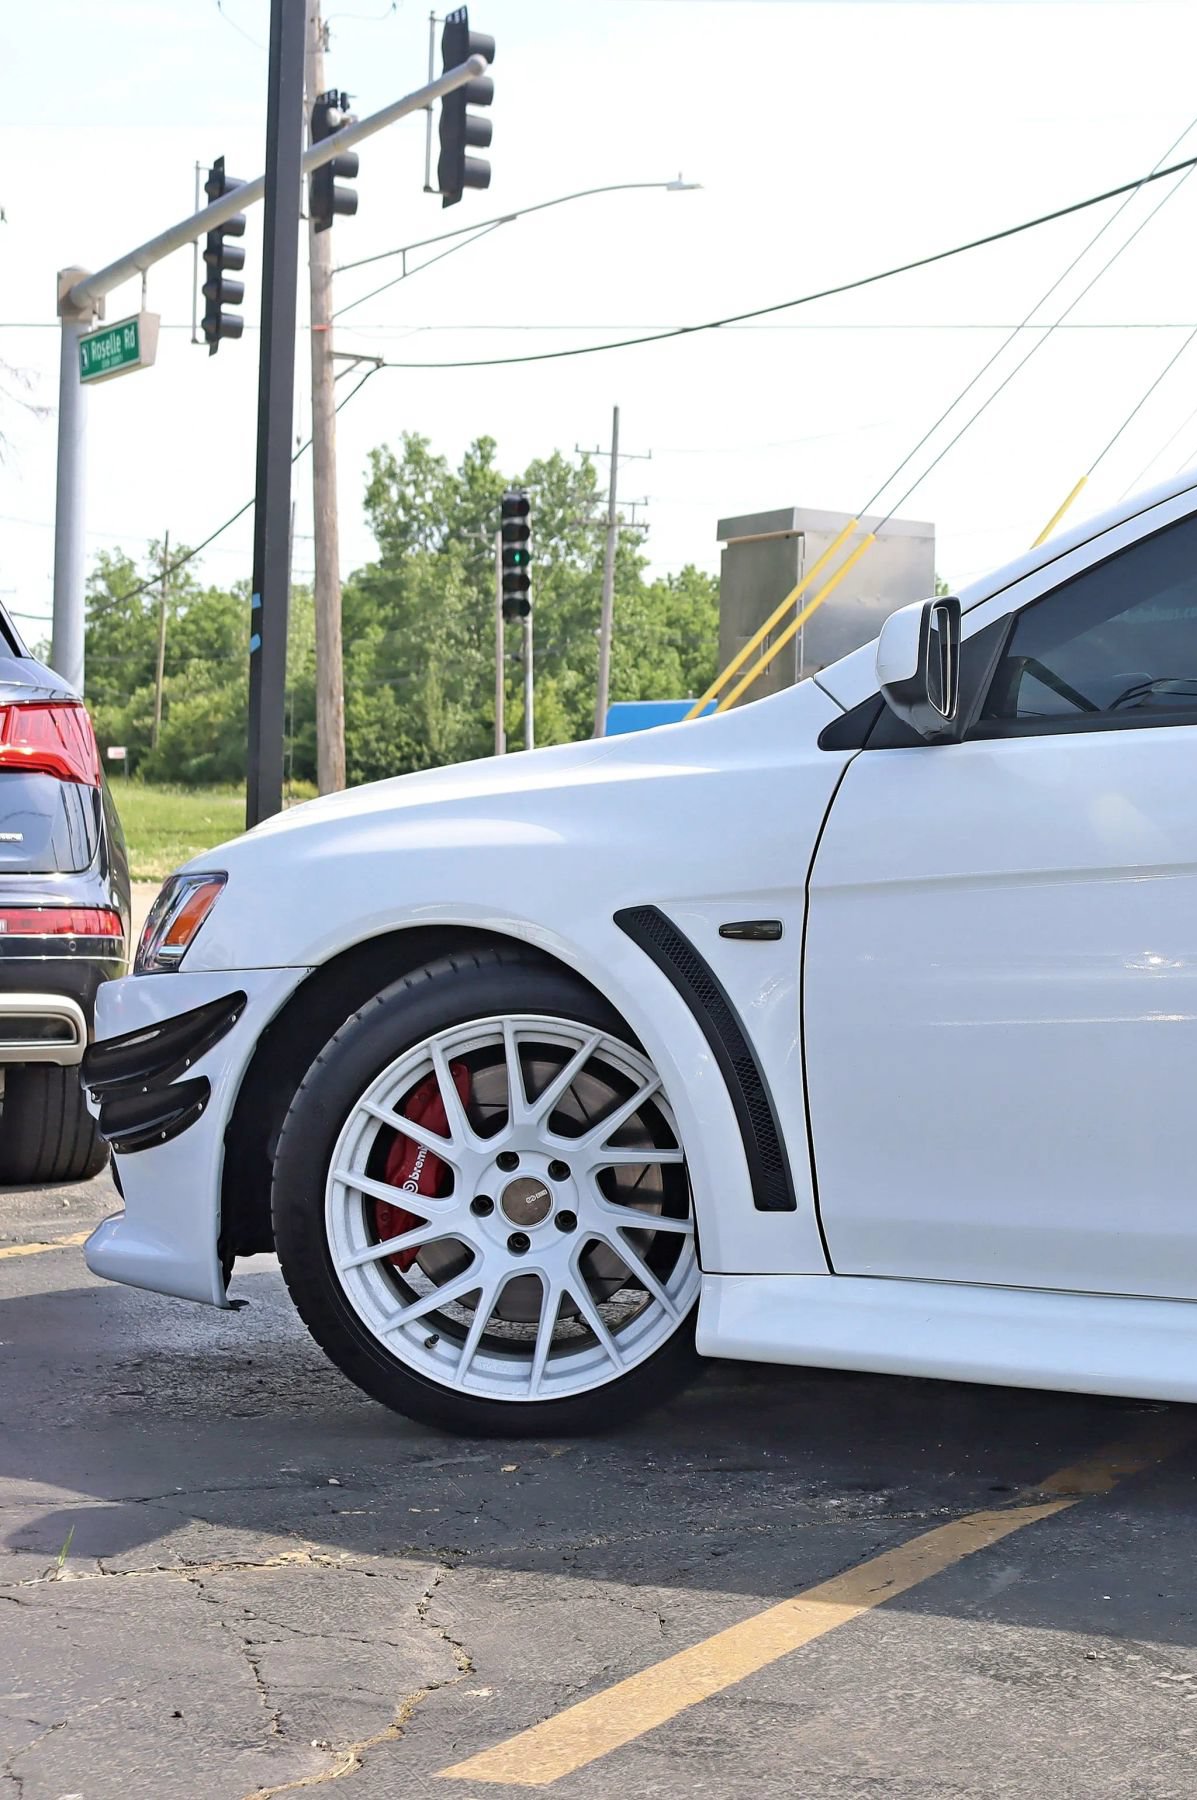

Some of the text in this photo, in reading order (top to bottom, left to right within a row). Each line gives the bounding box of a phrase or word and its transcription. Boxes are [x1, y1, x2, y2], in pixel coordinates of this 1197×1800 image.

[91, 332, 121, 362] Roselle
[124, 325, 135, 351] Rd
[409, 1145, 428, 1181] brem
